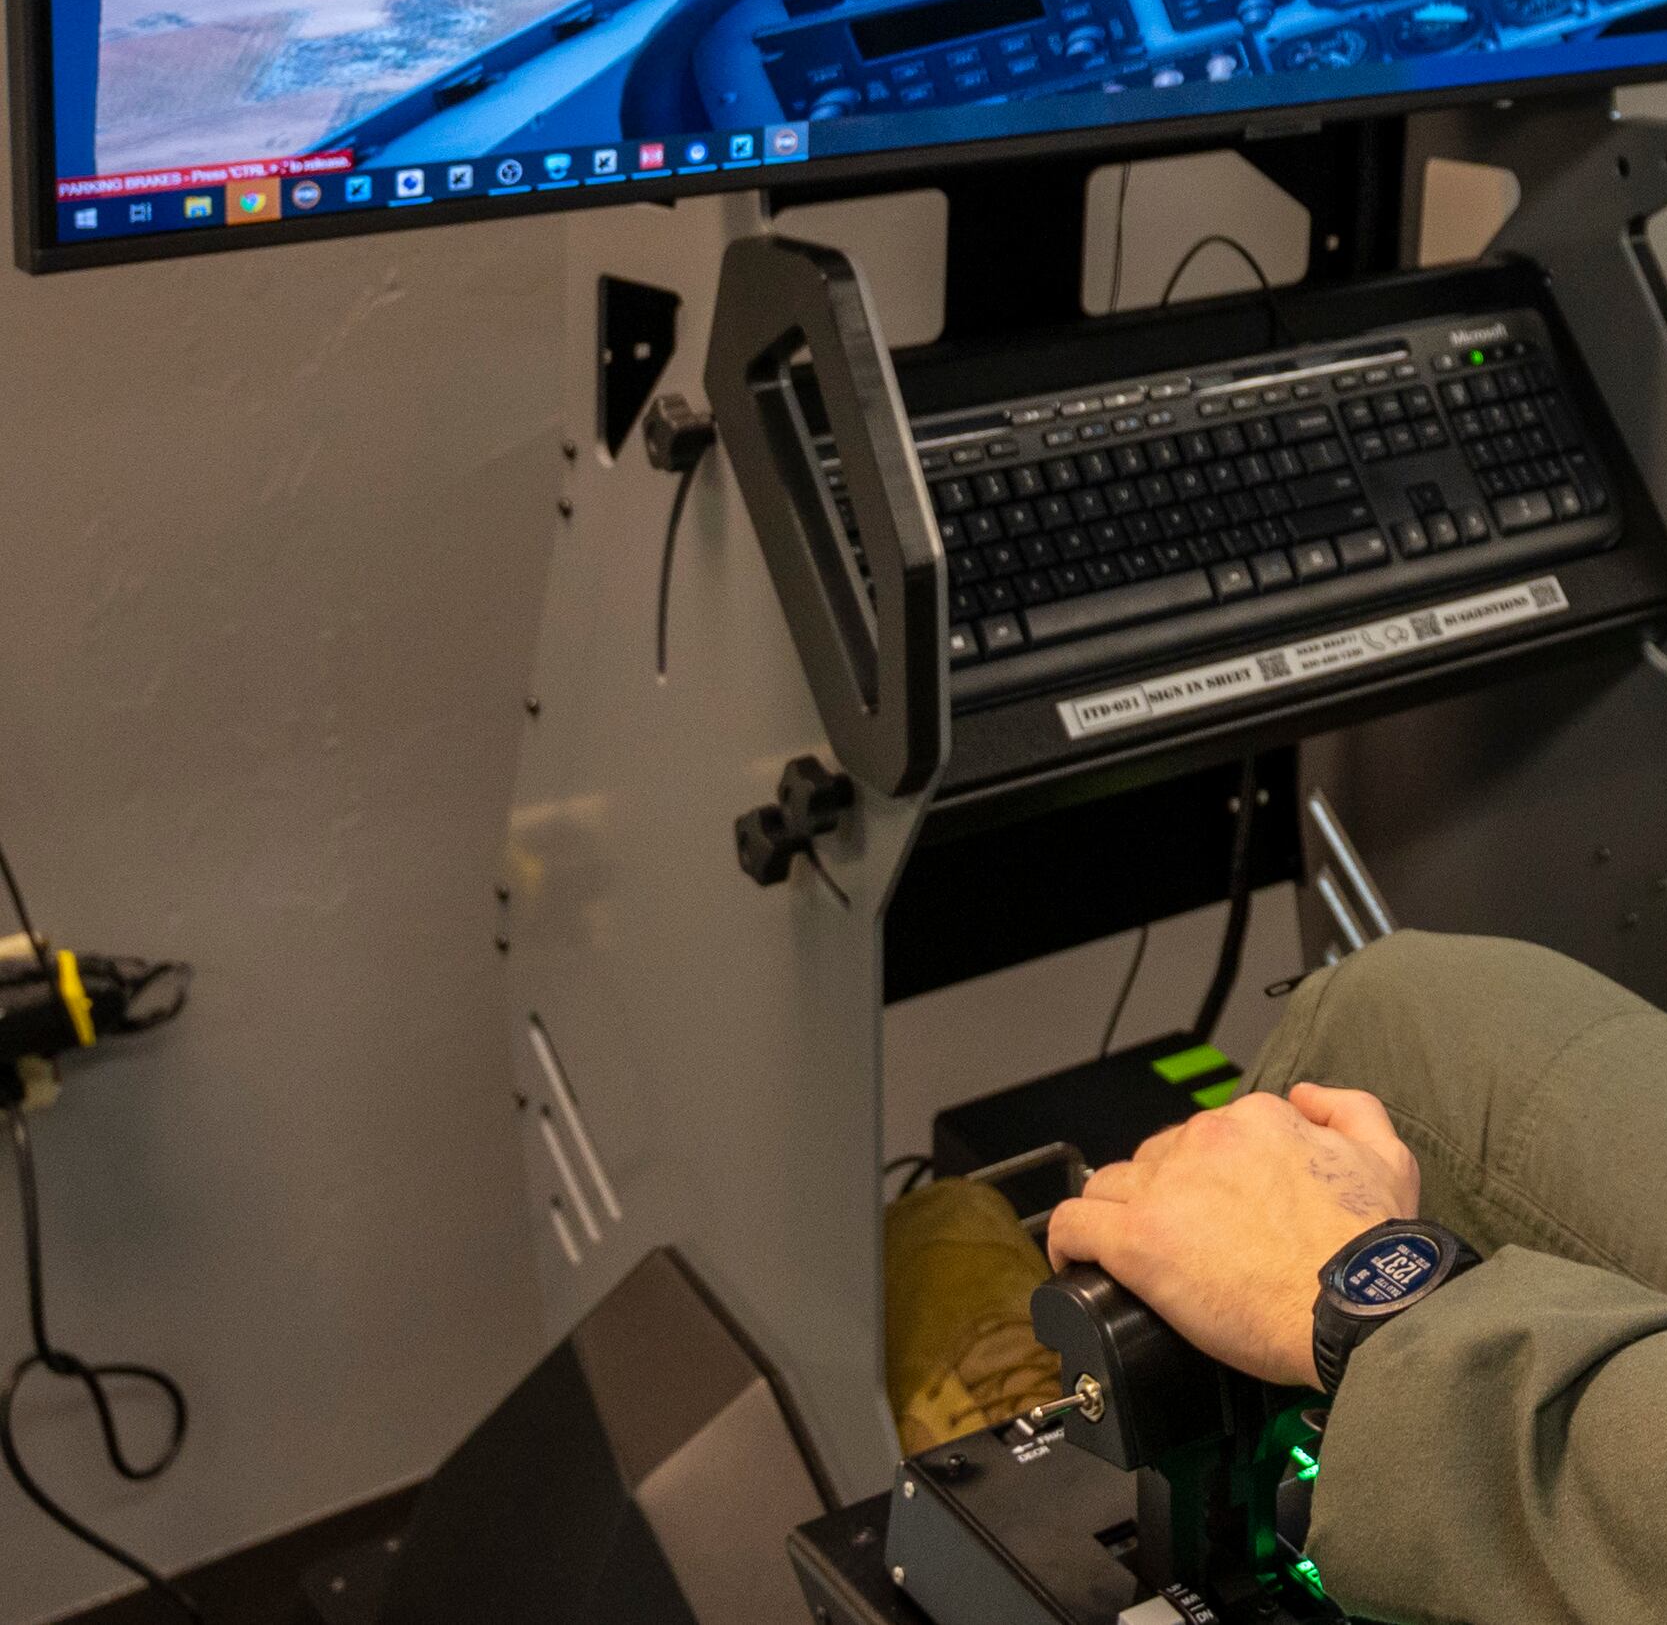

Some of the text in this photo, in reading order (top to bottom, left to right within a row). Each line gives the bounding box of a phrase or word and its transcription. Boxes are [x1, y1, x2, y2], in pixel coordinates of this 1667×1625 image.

[58, 177, 122, 197] PARKING
[124, 171, 182, 190] BRAKES
[1449, 322, 1509, 348] Microsoft
[1148, 685, 1184, 705] SIGN
[1186, 678, 1202, 696] IN
[1205, 667, 1252, 690] SHEET
[1377, 1251, 1423, 1285] 1237
